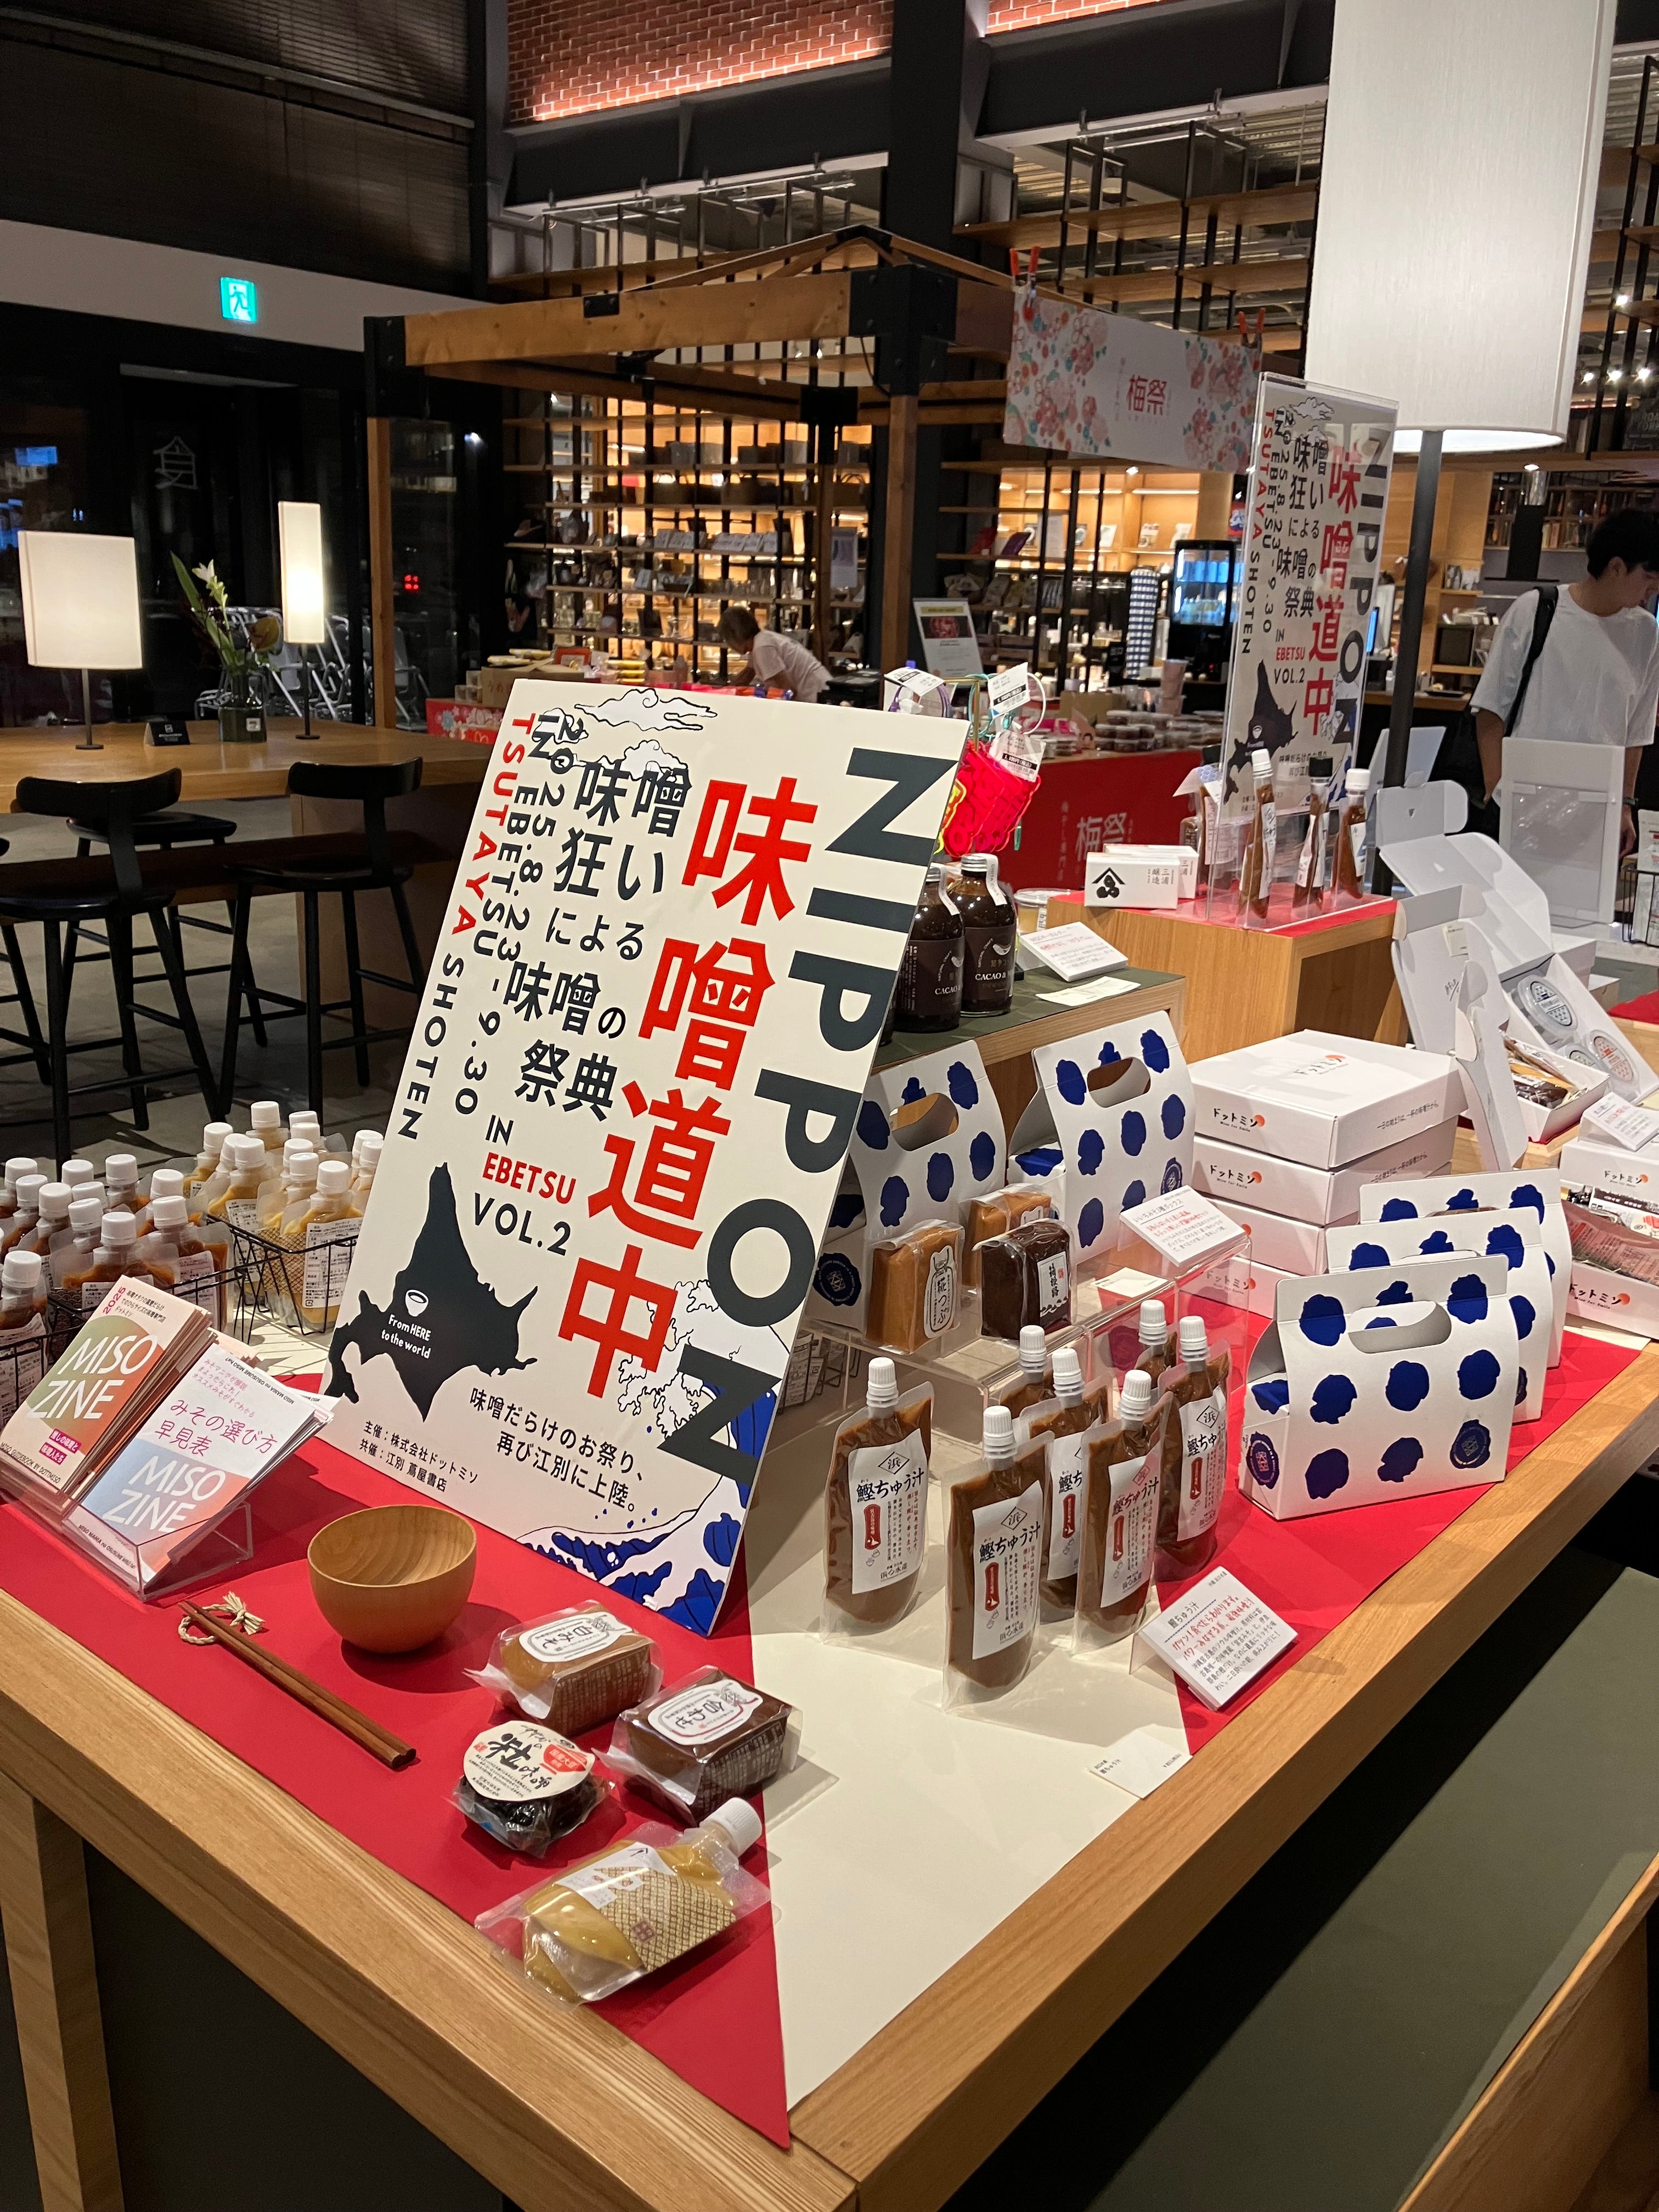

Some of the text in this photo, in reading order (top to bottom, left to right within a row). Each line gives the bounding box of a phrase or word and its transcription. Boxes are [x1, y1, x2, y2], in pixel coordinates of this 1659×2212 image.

[1126, 374, 1167, 415] 梅祭
[1293, 437, 1329, 476] 味噌
[1262, 452, 1282, 549] EBETSU
[1289, 475, 1324, 510] 狂い
[1241, 409, 1274, 654] TSUTAYA SHOTEN
[1289, 517, 1319, 539] による
[1277, 546, 1317, 580] 味噌の
[1284, 586, 1314, 619] 祭典
[1304, 443, 1361, 736] 味噌道中
[1333, 427, 1393, 744] NIPPON
[1276, 628, 1284, 642] IN
[1276, 647, 1306, 662] EBETSU
[1274, 667, 1305, 685] VOL.2
[573, 759, 693, 838] 味噌
[473, 715, 560, 957] IN EBETSU
[555, 828, 664, 901] 狂い
[398, 713, 534, 1141] TSUTAYA SHOTEN
[546, 907, 645, 961] による
[935, 986, 957, 995] CACAO
[975, 972, 1002, 981] CACAO
[503, 961, 627, 1040] 味噌の
[515, 1038, 618, 1123] 祭典
[557, 776, 819, 1399] 味噌道中
[485, 1114, 514, 1147] IN
[658, 747, 959, 1488] NIPPON
[1214, 1107, 1260, 1127] ドットミソ
[482, 1152, 577, 1205] EBETSU
[1210, 1164, 1257, 1184] ドットミソ
[1605, 1170, 1642, 1184] ドットミソ
[472, 1192, 572, 1257] VOL.2
[102, 1286, 127, 1315] 2025
[1569, 1283, 1622, 1305] ドットミソ
[381, 1329, 431, 1359] to the world
[388, 1314, 431, 1341] From HERE
[58, 1335, 159, 1375] MISO
[26, 1379, 123, 1420] ZINE
[154, 1420, 213, 1457] 早見表
[170, 1399, 279, 1454] みその選び方
[469, 1387, 644, 1482] 味噌だらけのお祭り、
[128, 1454, 225, 1502] MISO
[496, 1430, 636, 1514] 再び江別に上陸。
[856, 1467, 924, 1503] 鰹ちゅう汁
[101, 1488, 196, 1533] ZINE
[979, 1521, 1041, 1564] 鰹ちゅう汁
